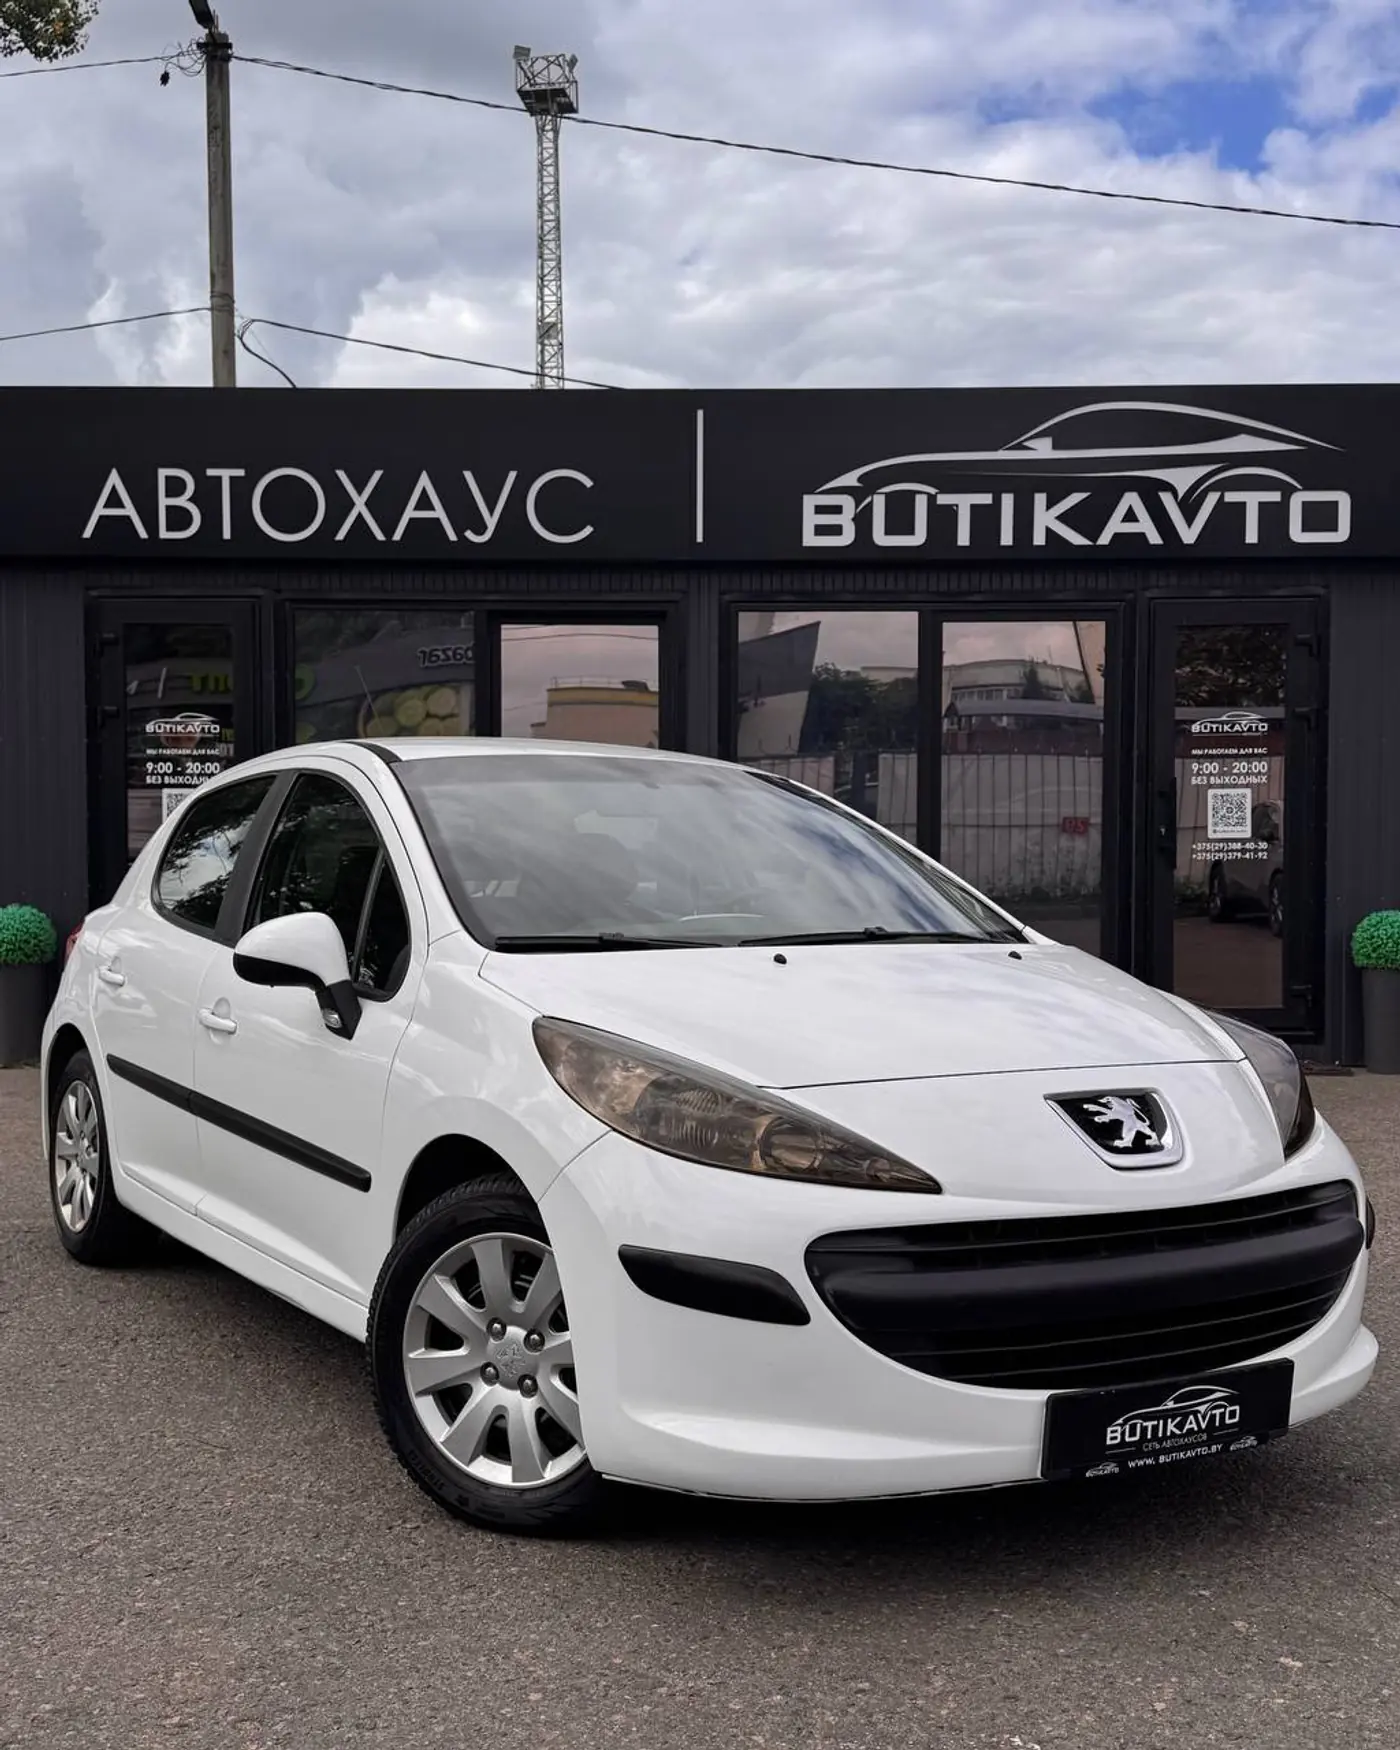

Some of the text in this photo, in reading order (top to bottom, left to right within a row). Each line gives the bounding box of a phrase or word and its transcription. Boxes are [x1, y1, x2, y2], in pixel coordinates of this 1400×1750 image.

[83, 466, 594, 543] АВТОХАУС
[802, 489, 1351, 547] BUTIKAVTO
[146, 723, 220, 733] BUTIKAVTO
[1191, 723, 1268, 733] BUTIKAVTO
[146, 761, 173, 774] 9:00
[185, 761, 220, 774] 20:00
[1191, 762, 1219, 774] 9:00
[1232, 761, 1268, 773] 20:00
[146, 775, 161, 784] БЕЗ
[1191, 775, 1268, 785] БЕЗ ВЫХОДНЫХ
[1106, 1405, 1240, 1446] BUTIKAVTO
[1159, 1443, 1223, 1464] BUTIKAVTO.BY
